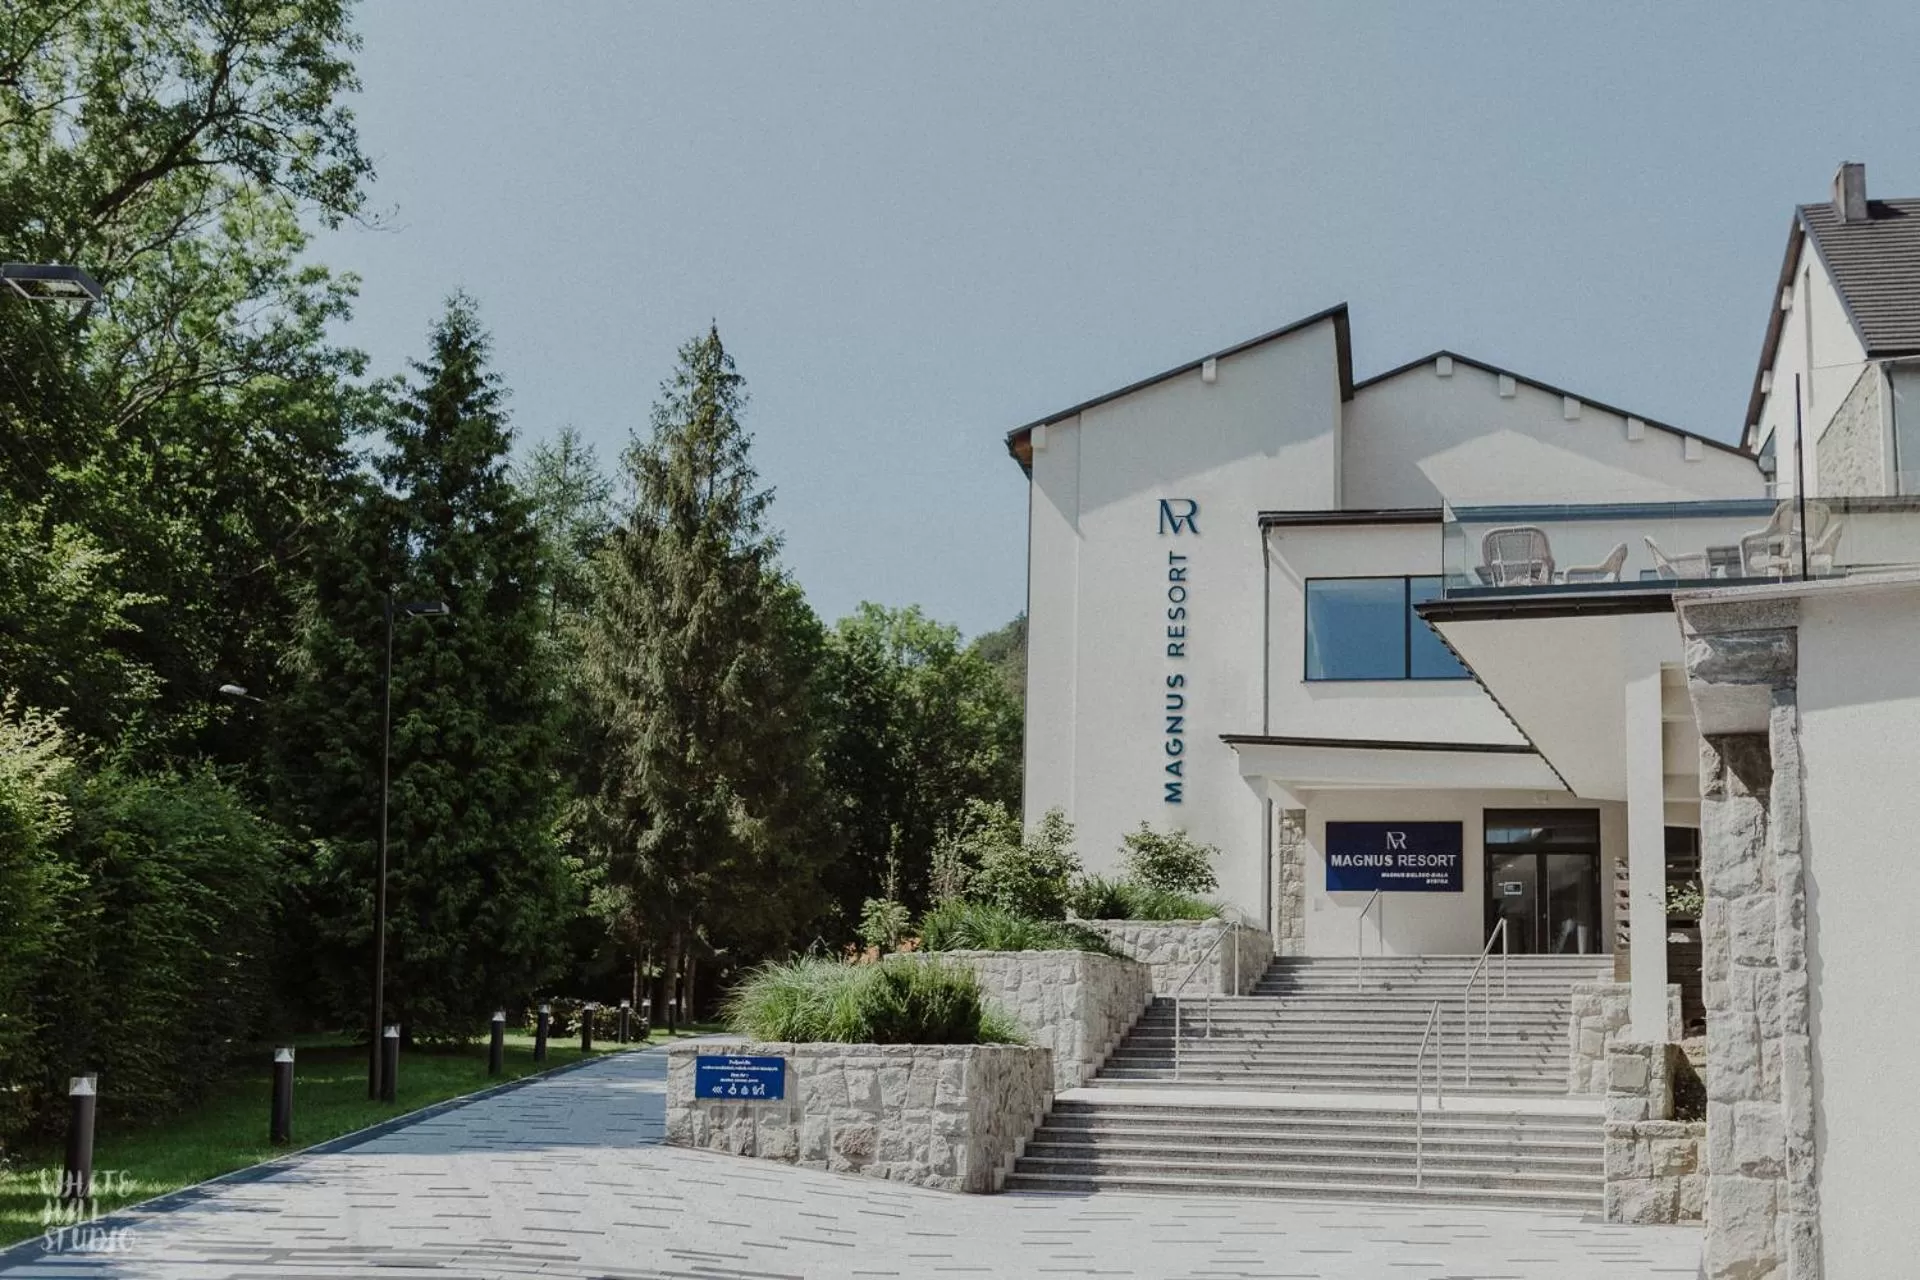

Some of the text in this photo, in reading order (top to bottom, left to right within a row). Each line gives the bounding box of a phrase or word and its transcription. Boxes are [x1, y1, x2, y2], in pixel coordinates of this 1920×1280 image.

[1164, 550, 1187, 804] MAGNUS RESORT
[1331, 854, 1457, 867] MAGNUS RESORT
